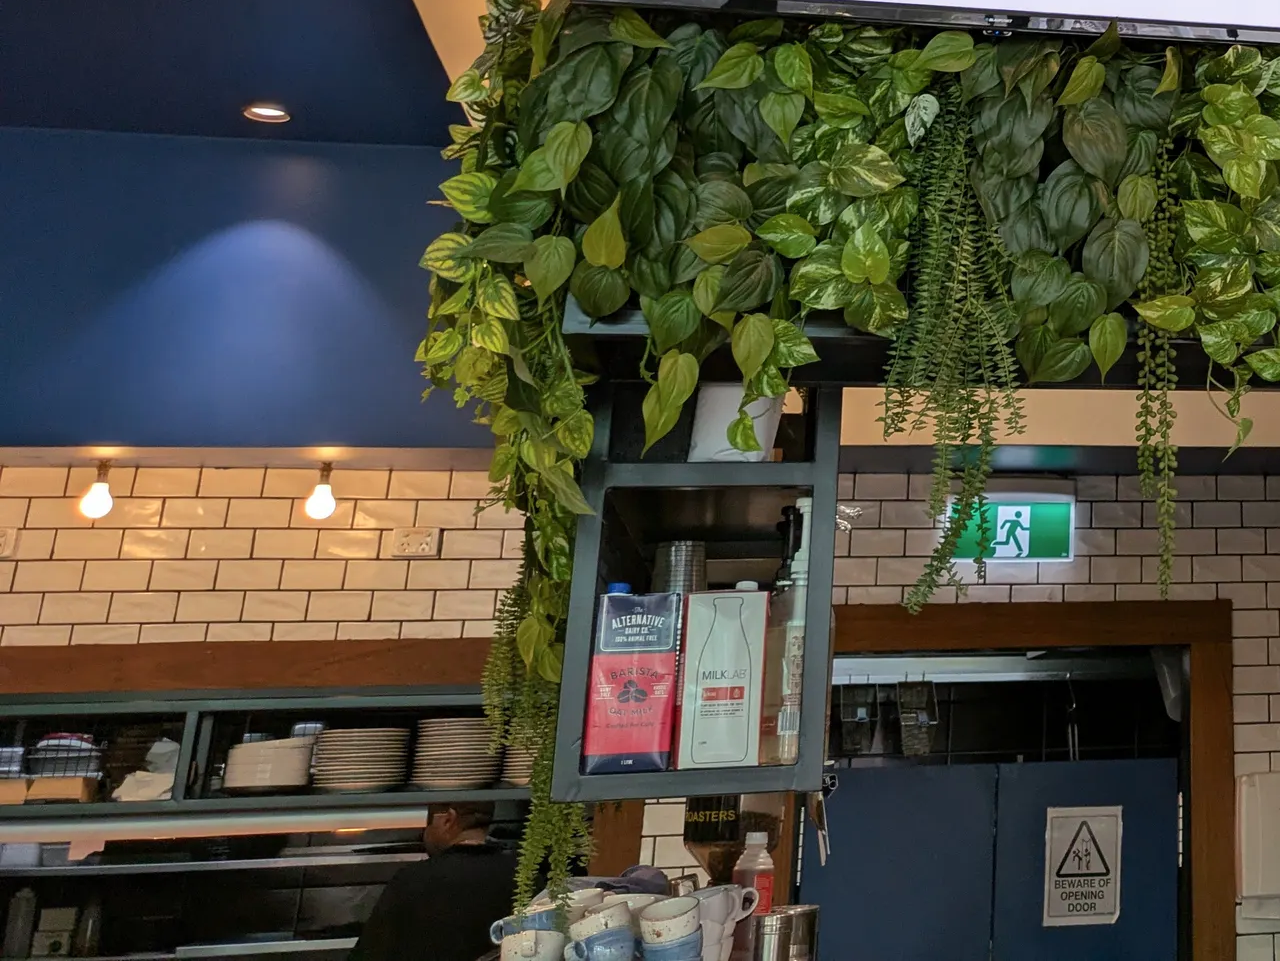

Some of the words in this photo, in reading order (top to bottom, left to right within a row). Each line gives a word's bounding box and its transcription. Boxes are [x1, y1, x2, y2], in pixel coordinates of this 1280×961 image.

[612, 614, 665, 630] ALTERNATIVE
[610, 667, 659, 680] BARISTA
[702, 669, 748, 680] MILKLAB
[1054, 879, 1095, 889] BEWARE
[1098, 878, 1111, 887] OF
[1061, 890, 1104, 901] OPENING
[1067, 902, 1096, 912] DOOR
